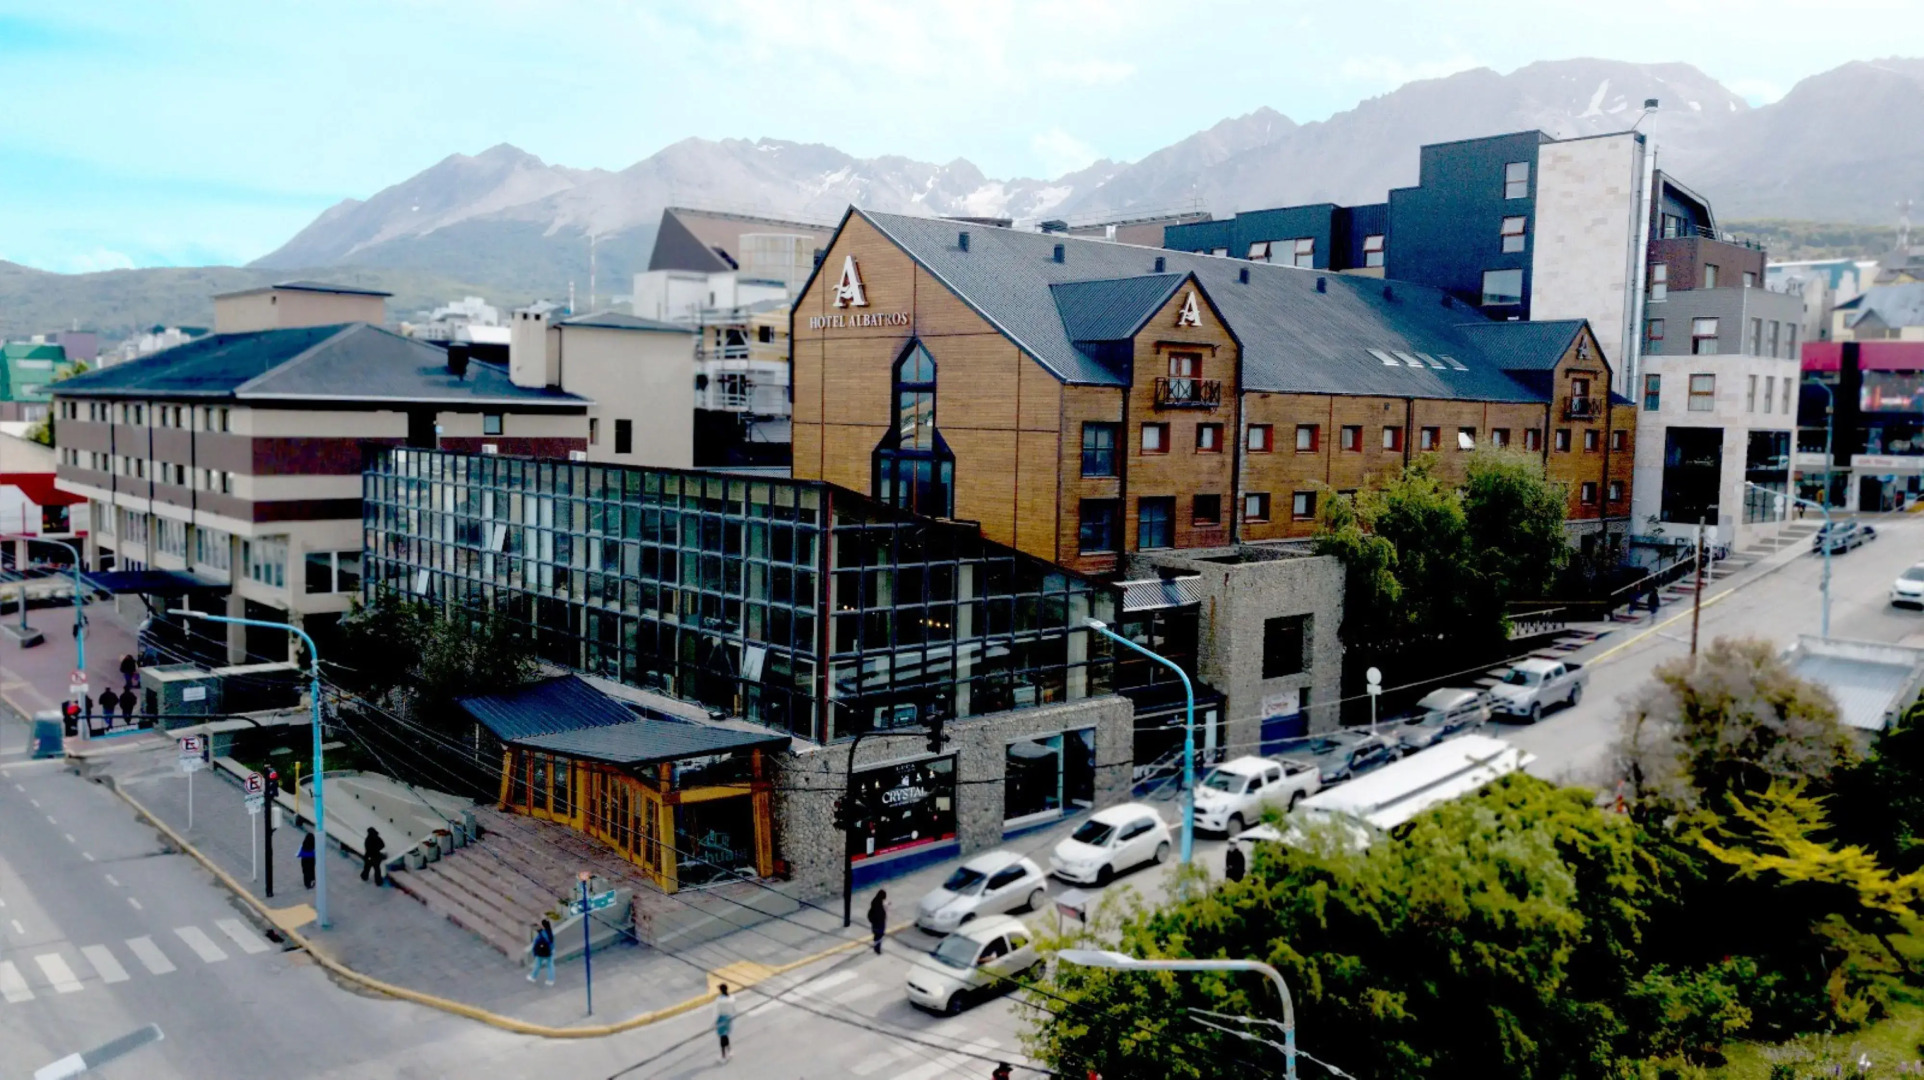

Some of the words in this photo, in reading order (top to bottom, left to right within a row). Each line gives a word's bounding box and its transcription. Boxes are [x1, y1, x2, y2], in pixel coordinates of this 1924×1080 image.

[832, 254, 867, 307] A
[810, 315, 845, 329] HOTEL
[849, 311, 908, 328] ALBATROS
[1179, 291, 1203, 327] A
[881, 786, 925, 804] CRYSTAL
